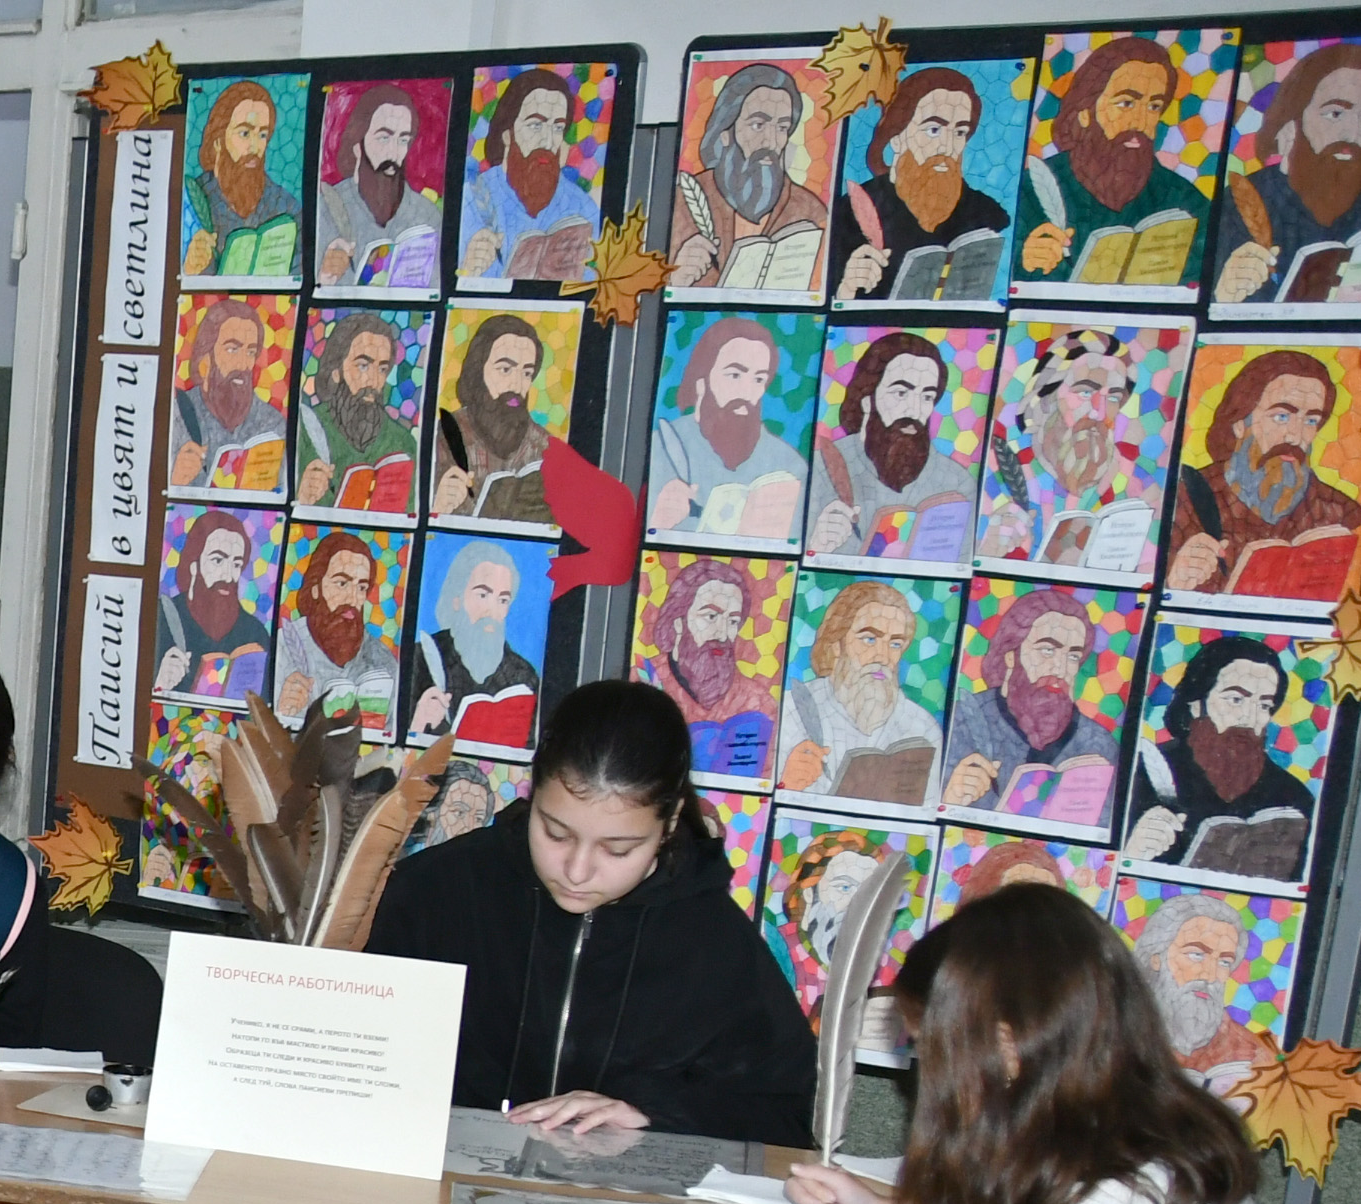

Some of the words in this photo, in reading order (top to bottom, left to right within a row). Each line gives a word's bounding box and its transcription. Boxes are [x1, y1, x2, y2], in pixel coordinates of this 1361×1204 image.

[123, 133, 152, 340] светлина
[117, 361, 139, 388] и
[112, 404, 141, 520] цвят
[111, 535, 132, 556] в
[88, 593, 125, 765] Паисий
[206, 965, 284, 986] ТВОРЧЕСКА
[288, 975, 395, 1000] РАБОТИЛНИЦА
